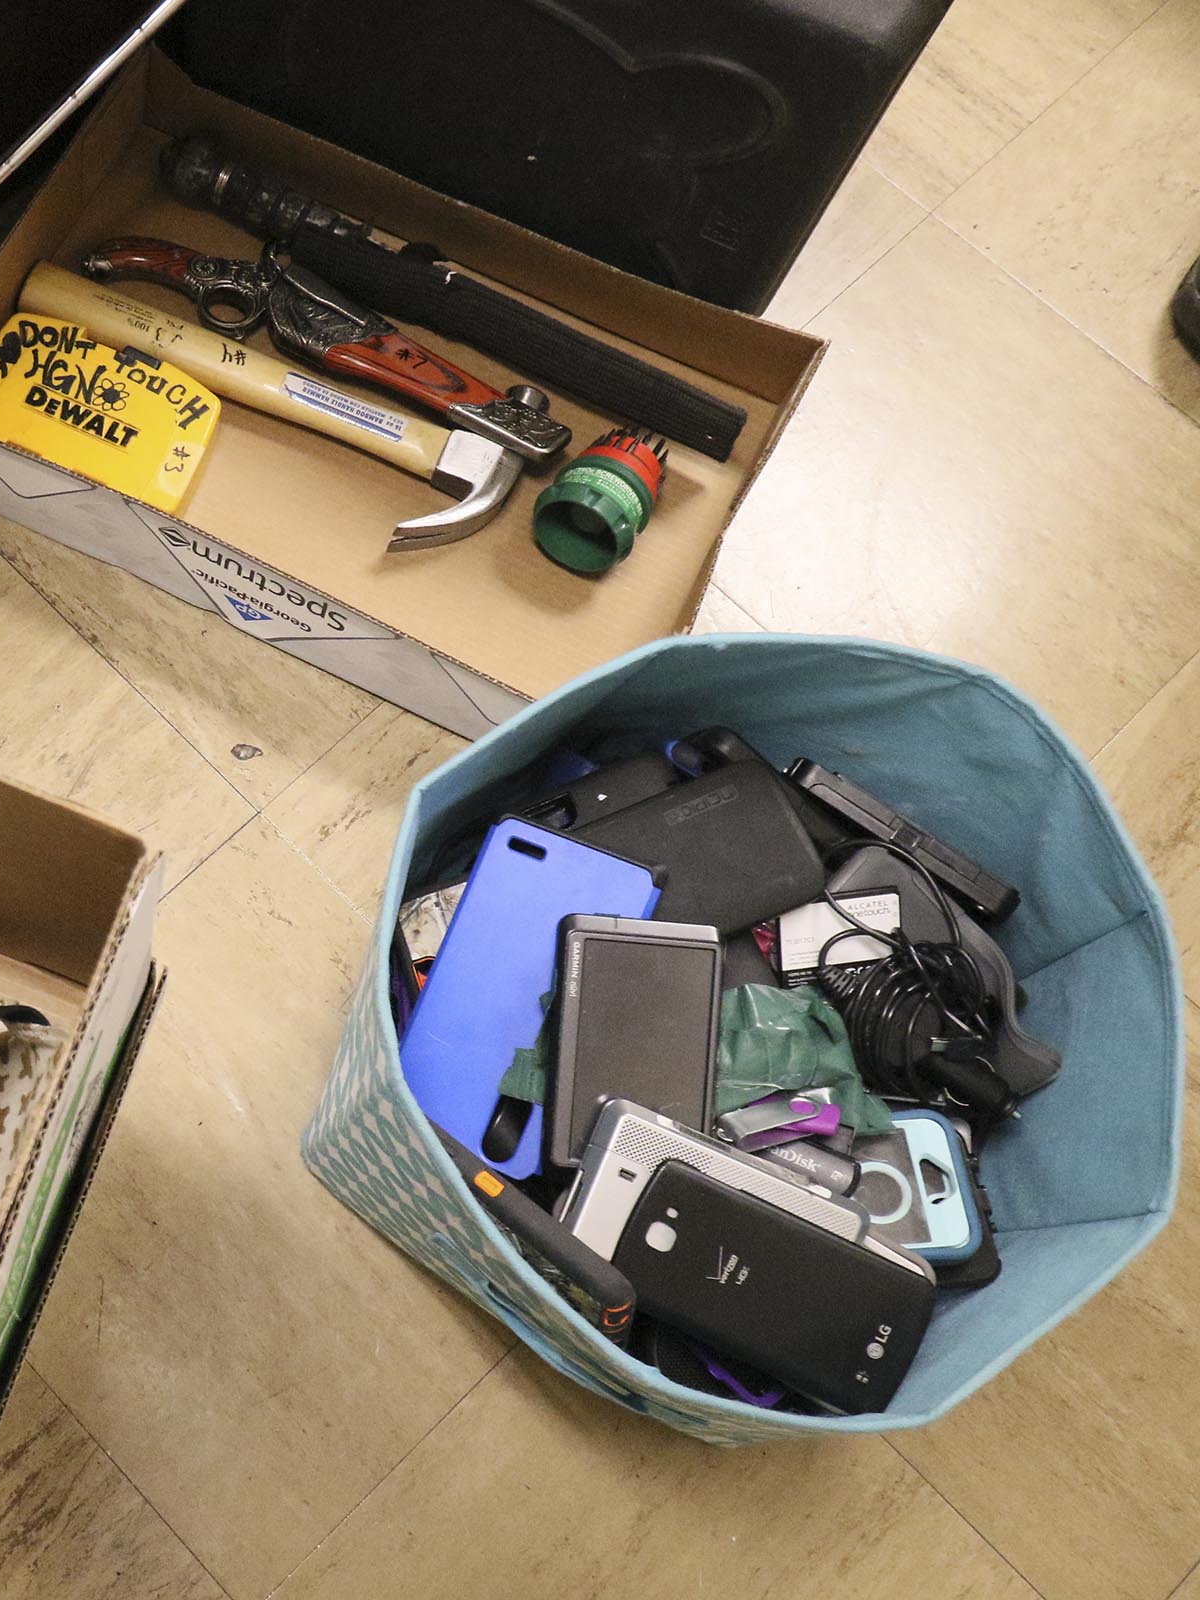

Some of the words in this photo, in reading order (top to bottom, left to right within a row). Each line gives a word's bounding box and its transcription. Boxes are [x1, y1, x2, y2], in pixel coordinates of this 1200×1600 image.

[220, 342, 248, 367] #4
[394, 347, 430, 370] #7
[114, 344, 211, 430] TOUCH
[302, 386, 330, 403] HAMMER
[331, 399, 355, 413] HANDLE
[355, 408, 384, 425] BAMBOO
[163, 445, 192, 474] #3
[191, 540, 349, 632] Spectrum
[194, 569, 312, 632] Georgia-Pacific
[848, 900, 890, 911] ALCATEL
[570, 941, 581, 979] GARMIN
[770, 1146, 821, 1174] anDisk
[719, 1254, 739, 1284] verizon
[874, 1323, 893, 1344] LG
